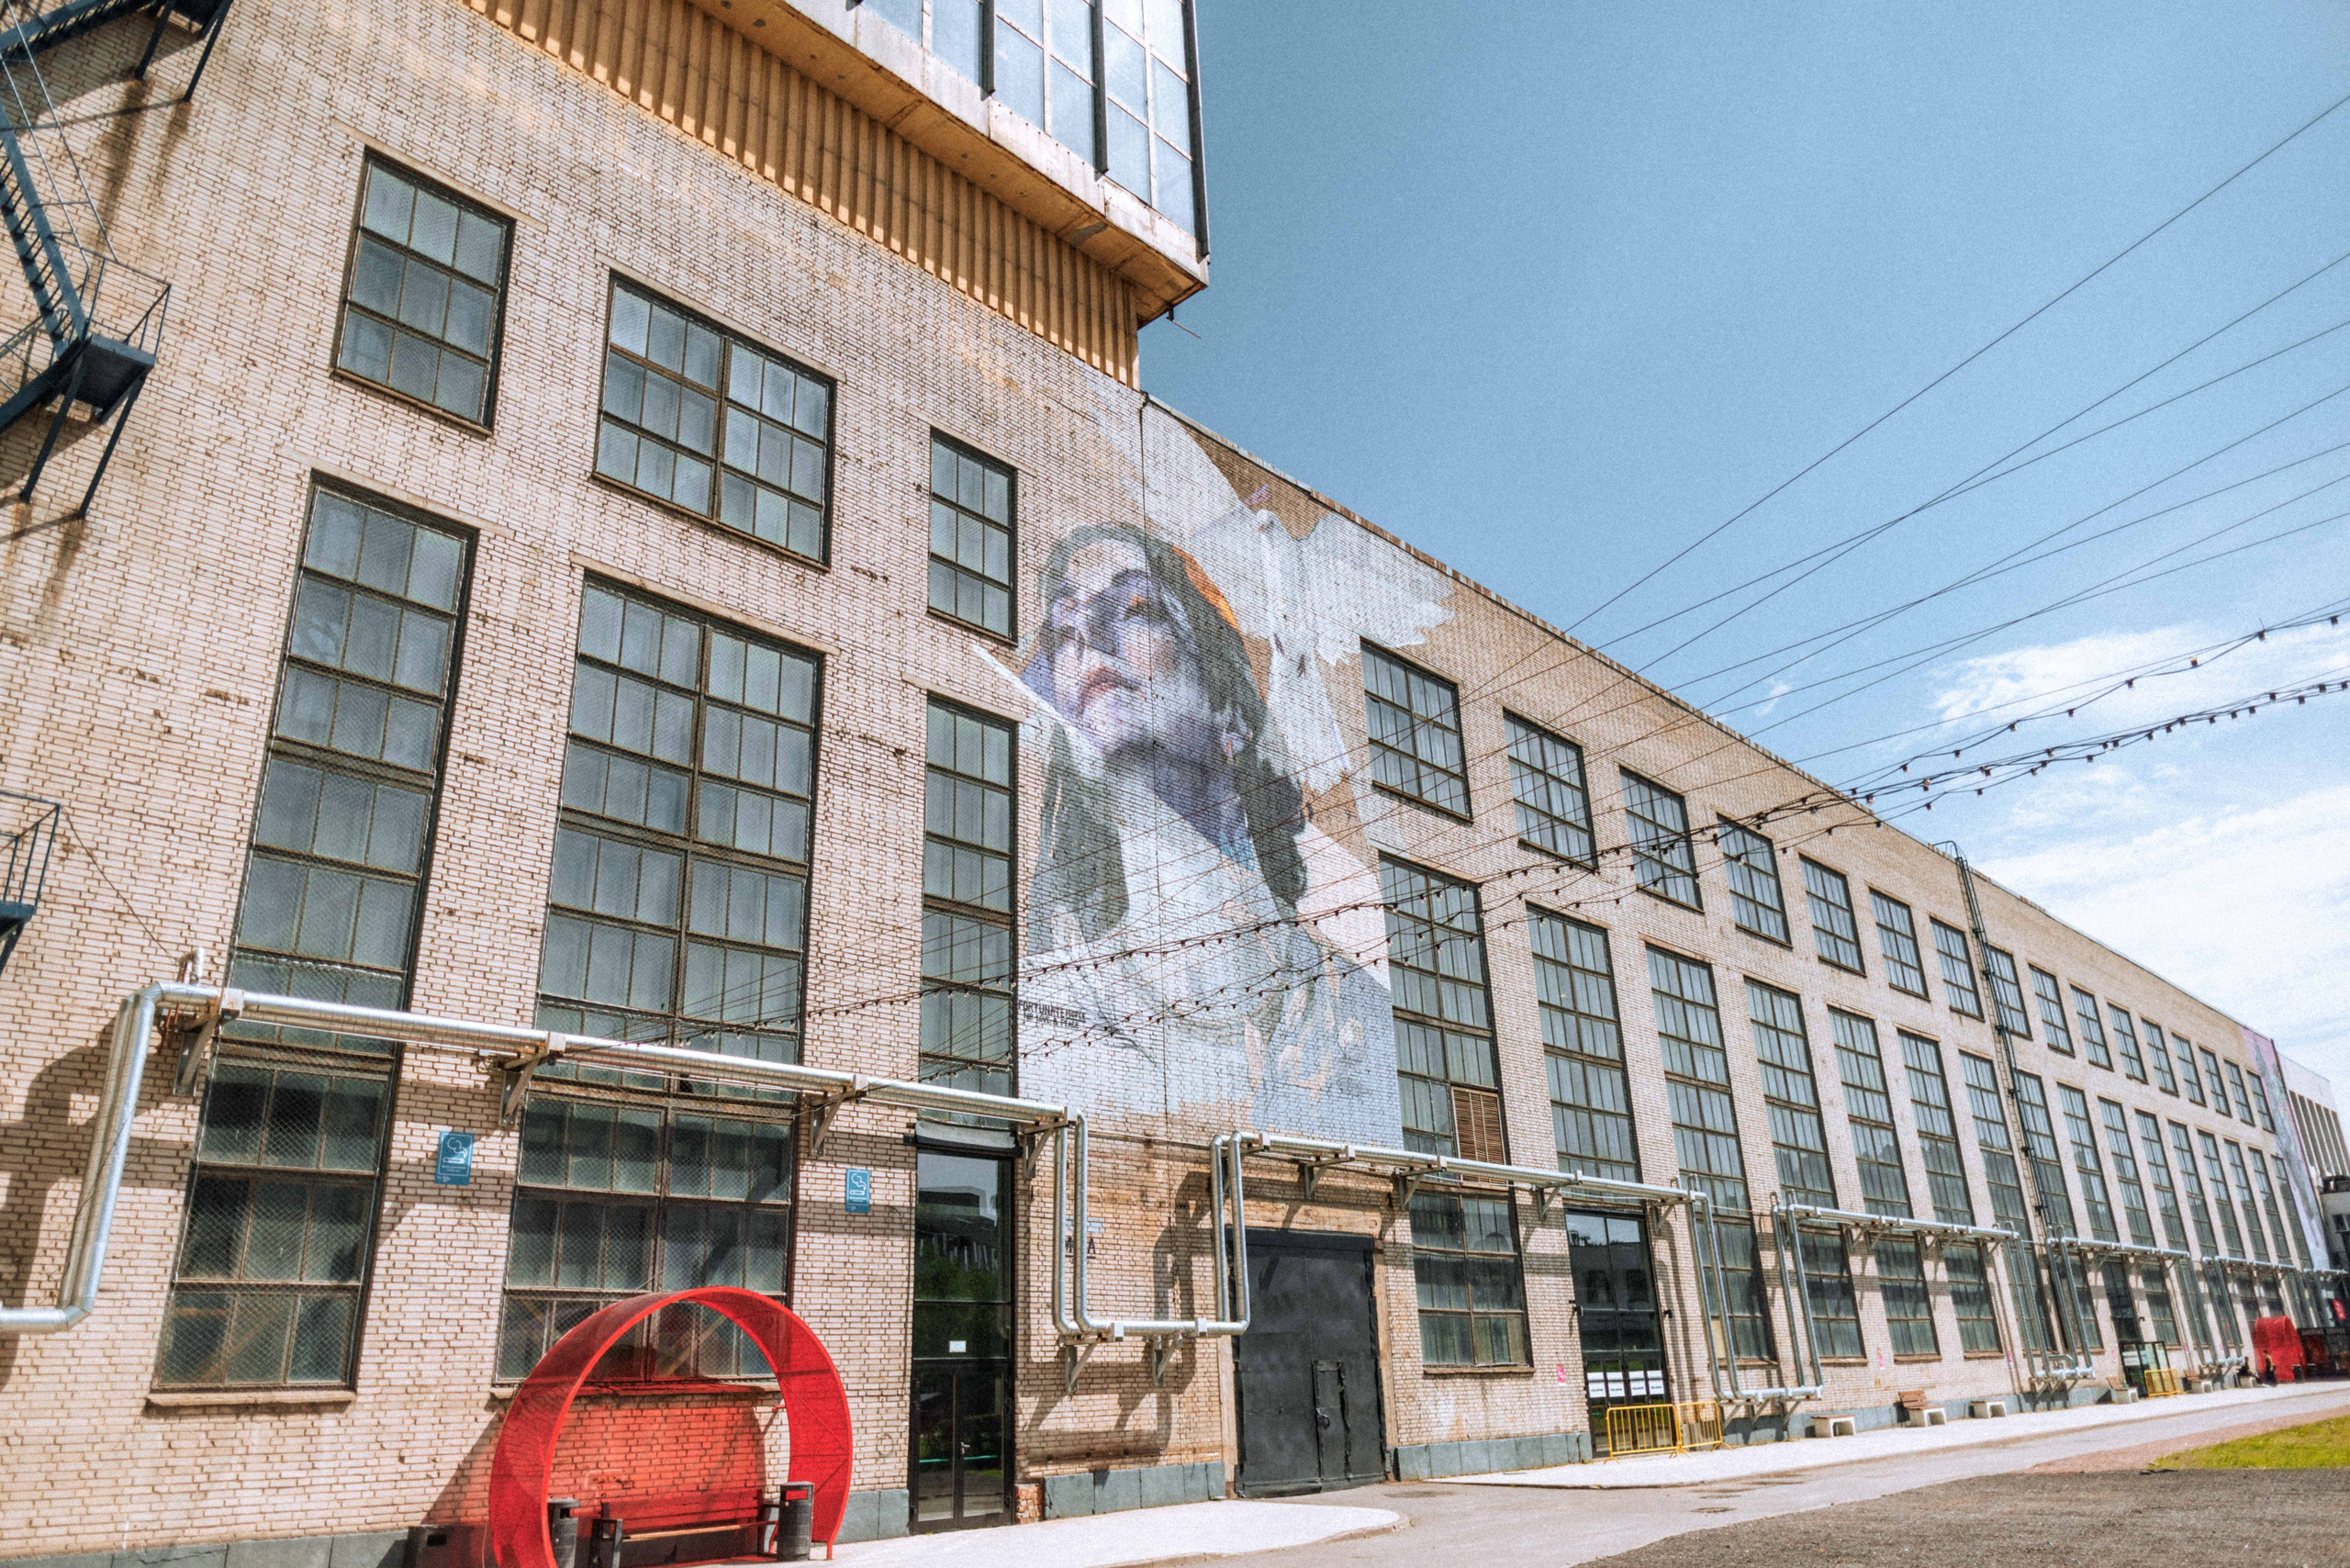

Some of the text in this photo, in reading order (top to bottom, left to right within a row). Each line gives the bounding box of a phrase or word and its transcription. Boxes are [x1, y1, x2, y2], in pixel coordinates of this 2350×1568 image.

[1018, 1000, 1065, 1018] FORTUNATE
[1035, 1014, 1050, 1024] LOVE
[1060, 1018, 1080, 1028] PEACE
